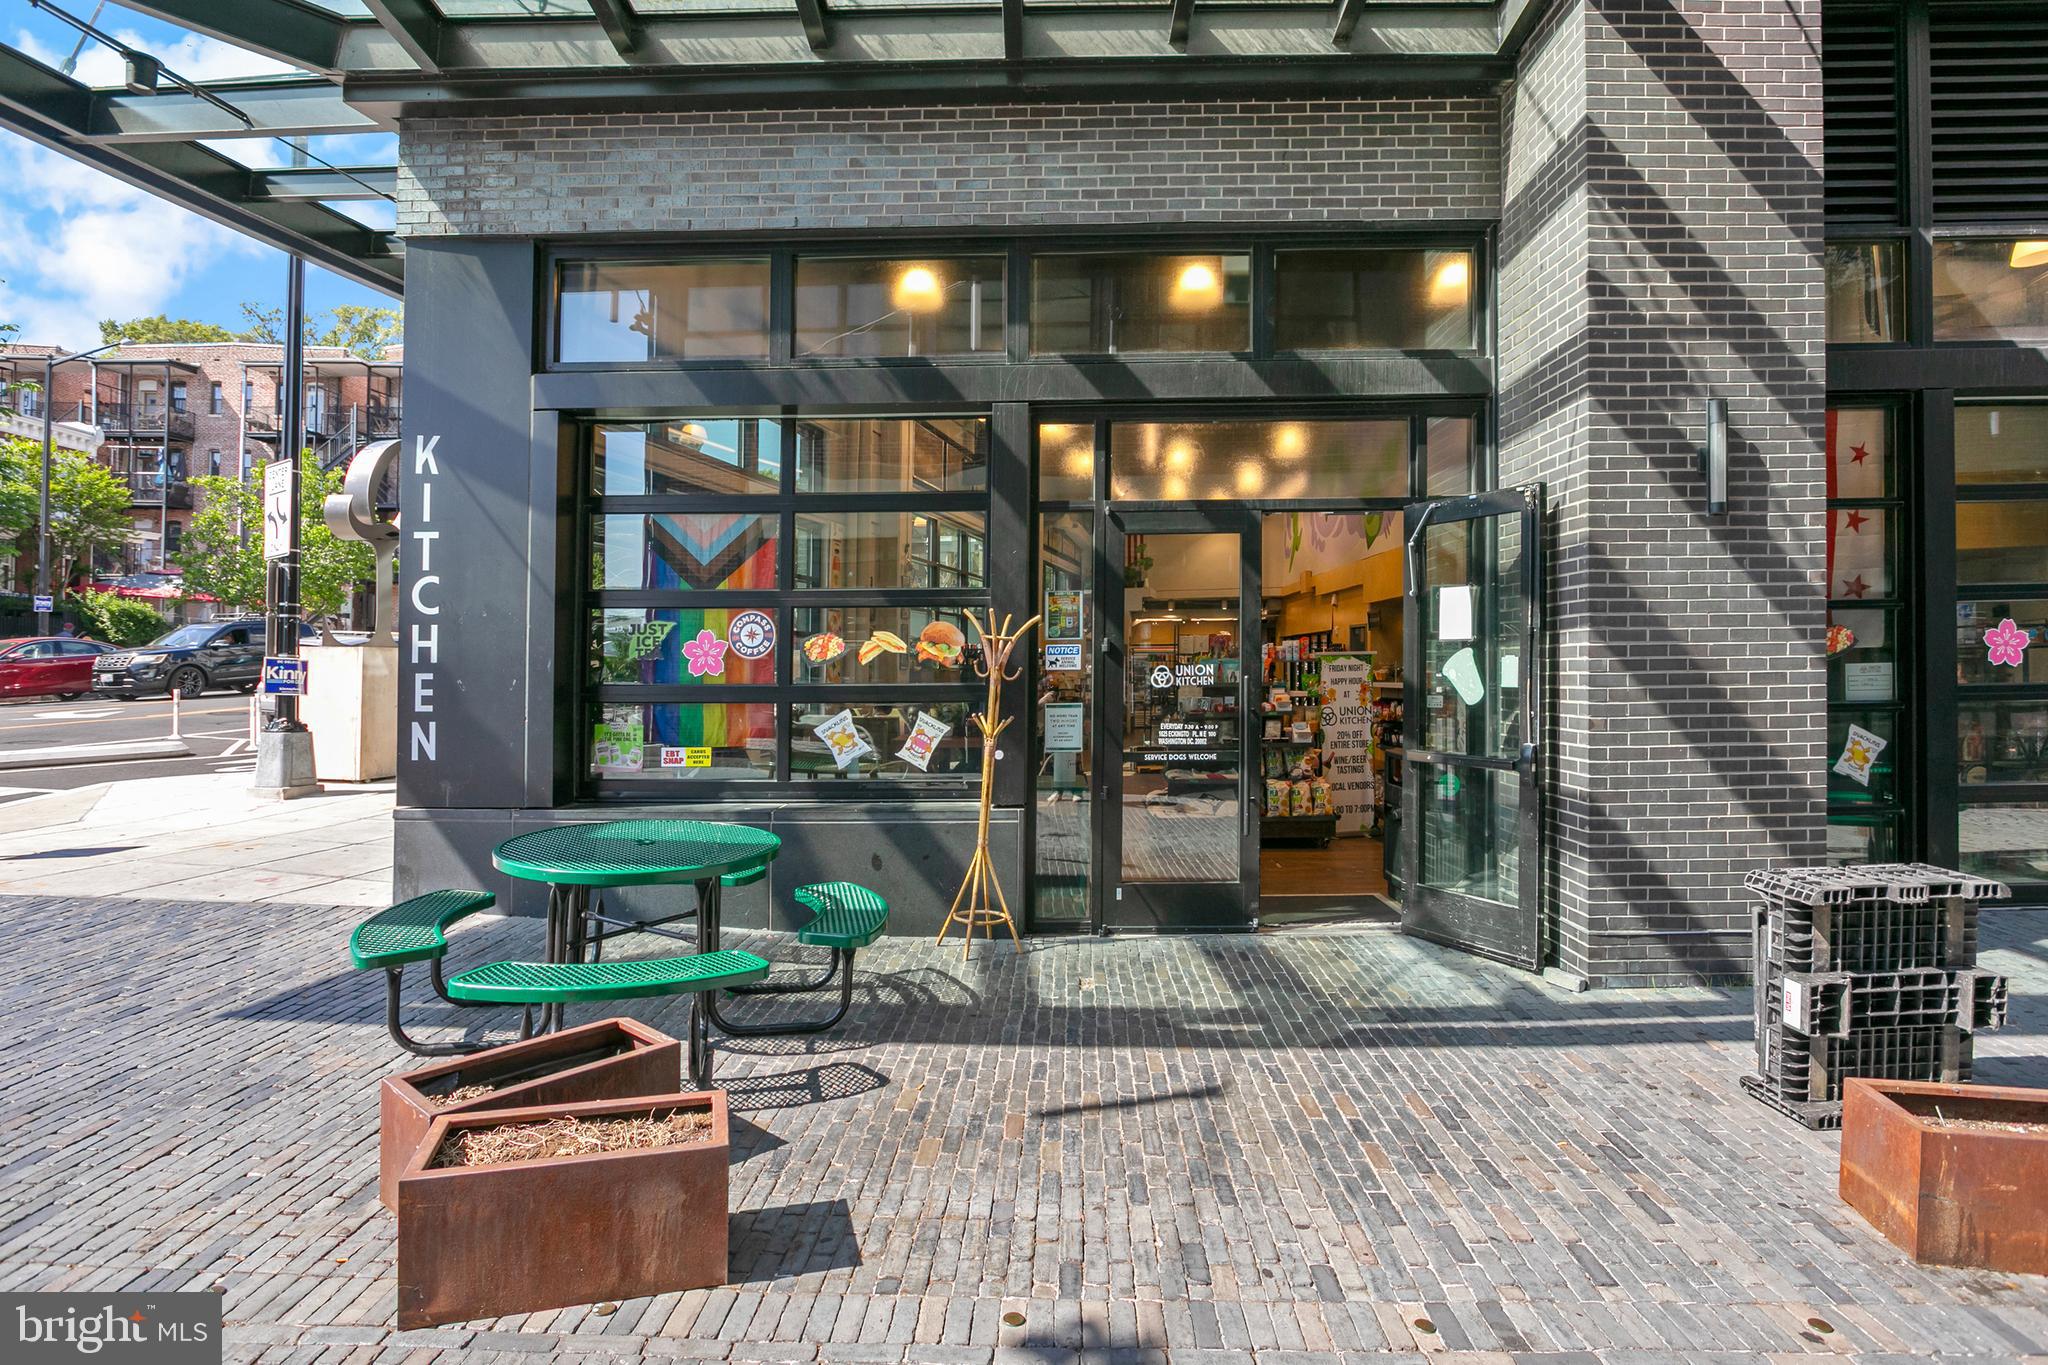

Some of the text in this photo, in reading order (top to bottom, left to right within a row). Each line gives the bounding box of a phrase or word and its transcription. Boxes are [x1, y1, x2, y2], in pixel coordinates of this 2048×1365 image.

[411, 435, 440, 761] KITCHEN
[733, 615, 771, 633] COMPASS
[629, 624, 668, 635] JUST
[636, 636, 661, 648] ICE
[736, 640, 770, 655] COFFEE
[1048, 646, 1079, 654] NOTICE
[1176, 664, 1214, 676] UNION
[1328, 664, 1347, 672] FRIDAY
[1176, 676, 1214, 686] KITCHEN
[1343, 690, 1350, 698] AT
[1339, 706, 1372, 716] UNION
[1340, 716, 1373, 725] KITCHEN
[1337, 730, 1363, 740] 20% OFF
[1330, 740, 1369, 749] ENTIRE STORE
[1334, 755, 1367, 764] WINE/BEER
[1337, 765, 1365, 774] TASTINGS
[1331, 781, 1375, 791] OCAL VENDORS
[1345, 805, 1353, 813] TO
